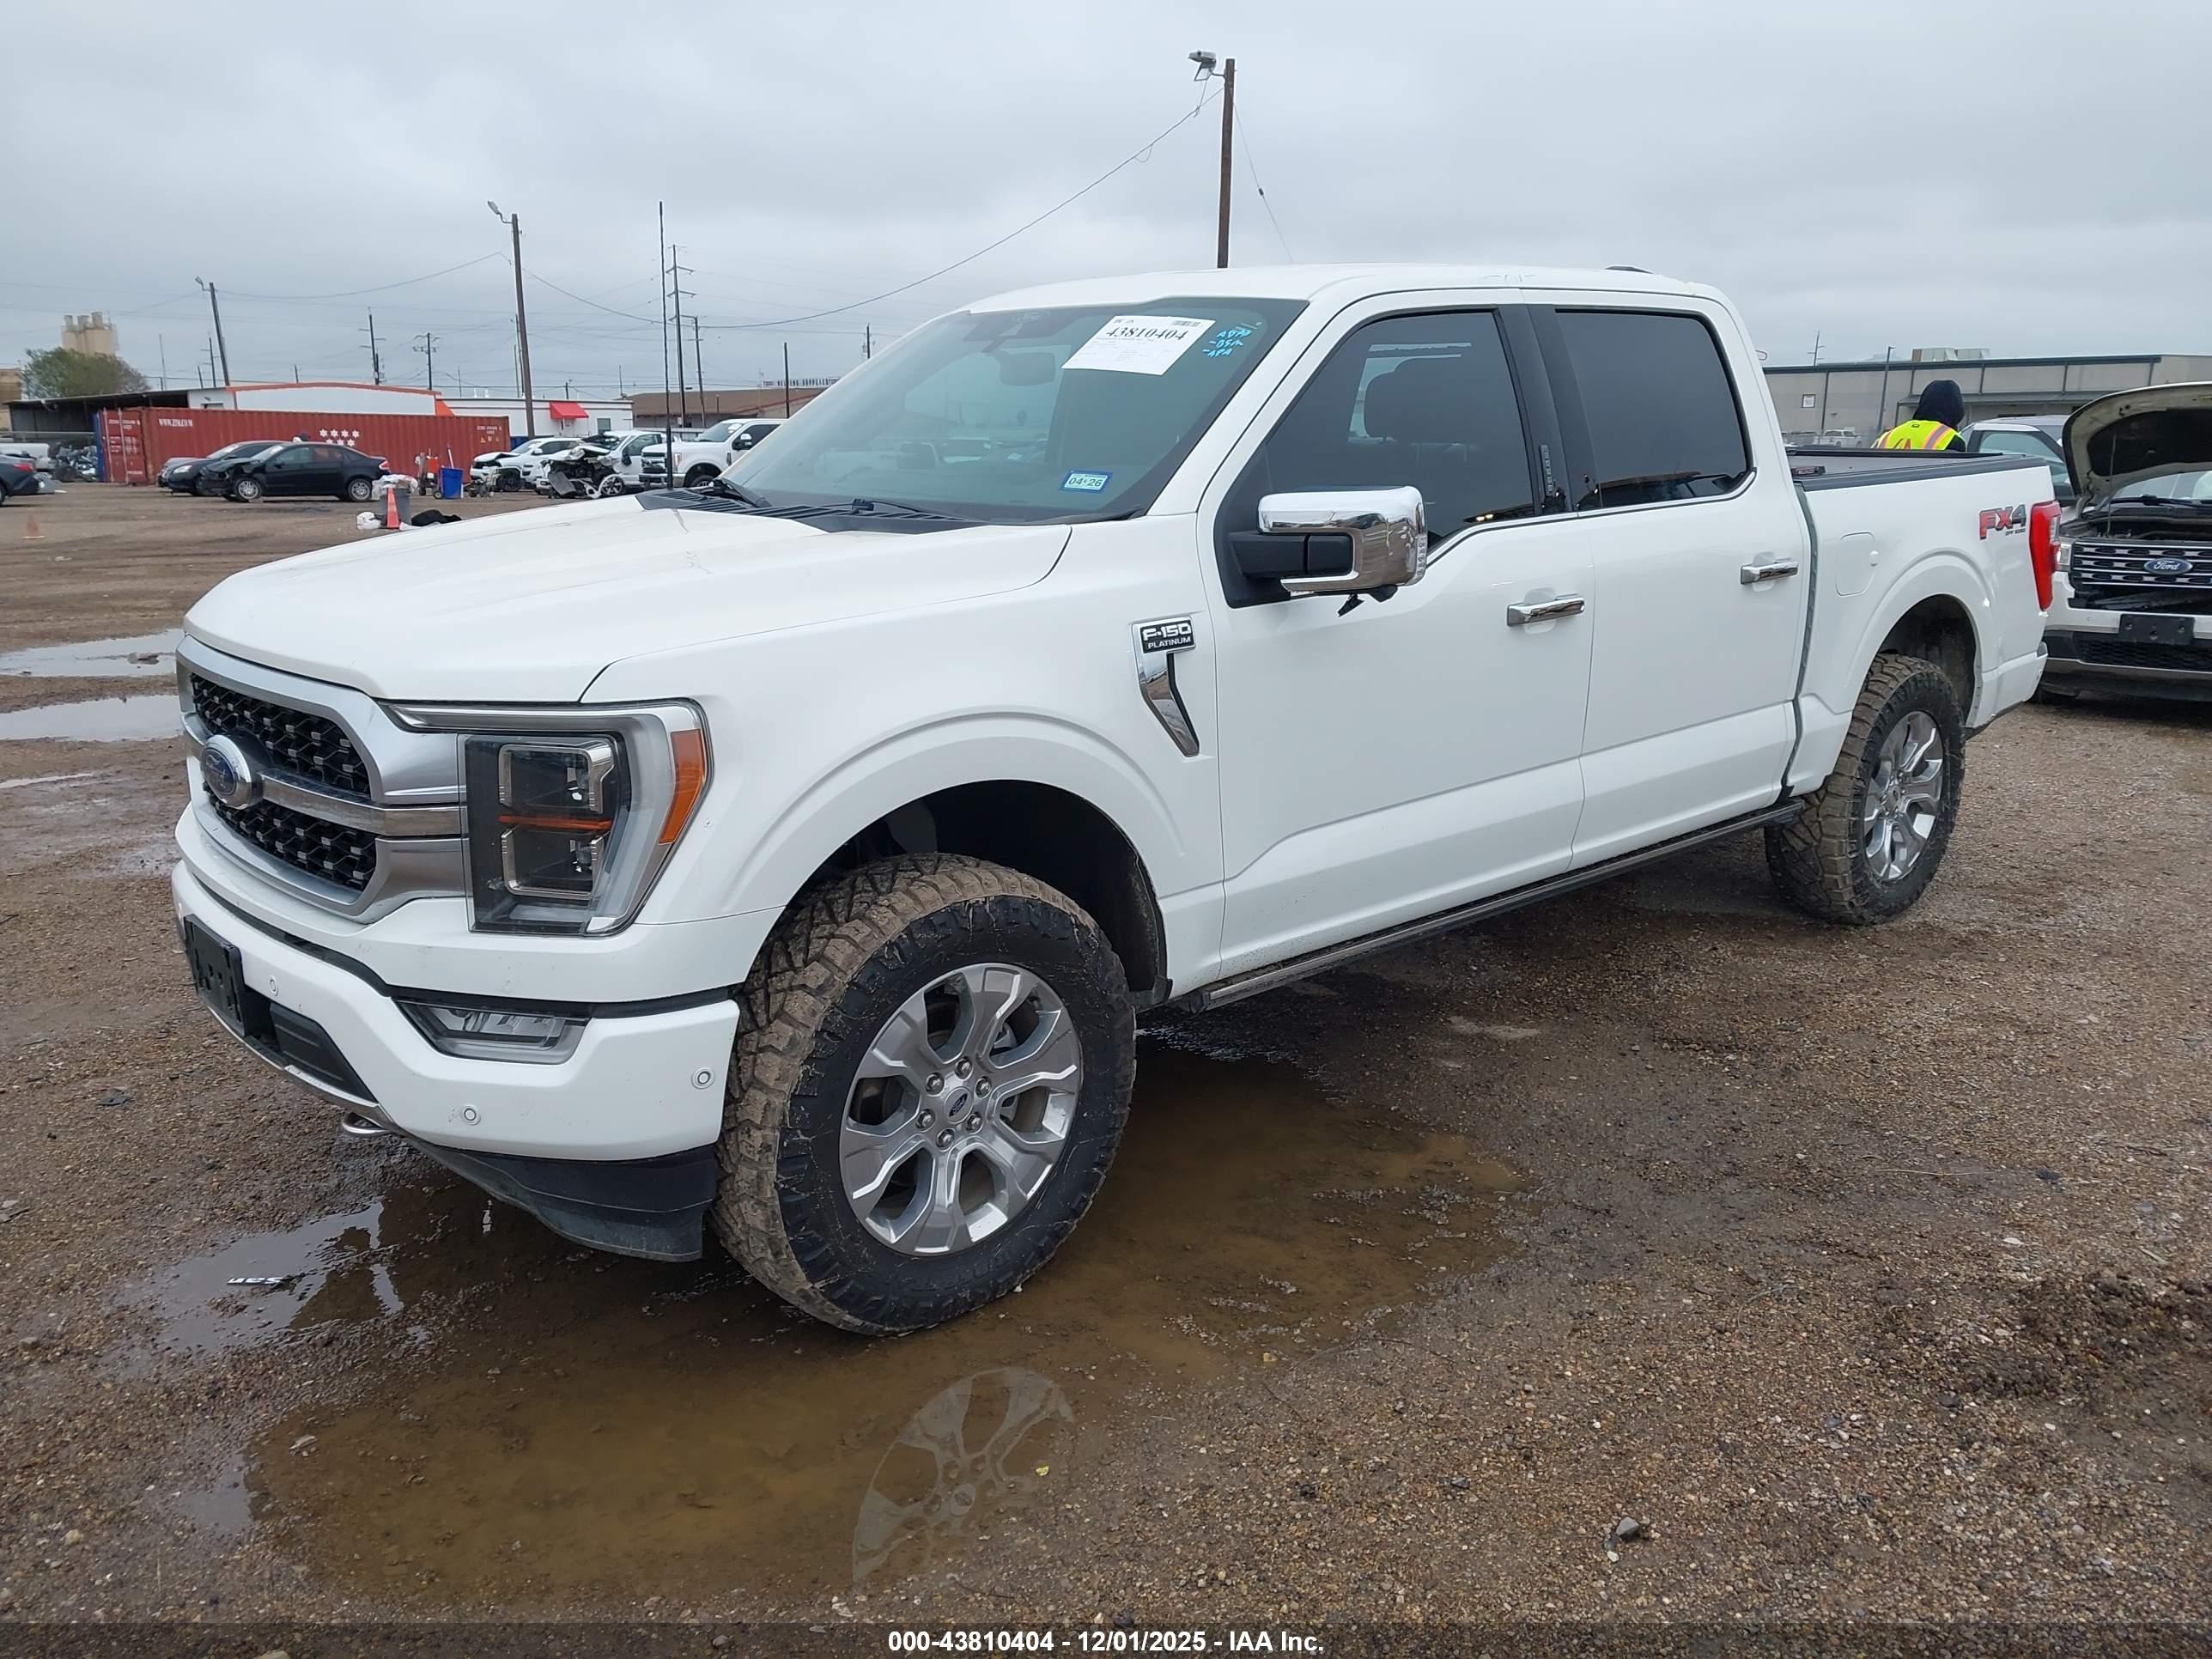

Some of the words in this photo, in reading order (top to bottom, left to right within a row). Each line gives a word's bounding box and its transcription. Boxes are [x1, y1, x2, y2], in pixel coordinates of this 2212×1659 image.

[1106, 325, 1189, 341] 43810404
[1086, 478, 1103, 487] 26
[1979, 504, 2027, 540] FX4
[2153, 559, 2182, 571] Ford
[1142, 623, 1192, 641] F-150
[1147, 636, 1191, 649] PLATINUM
